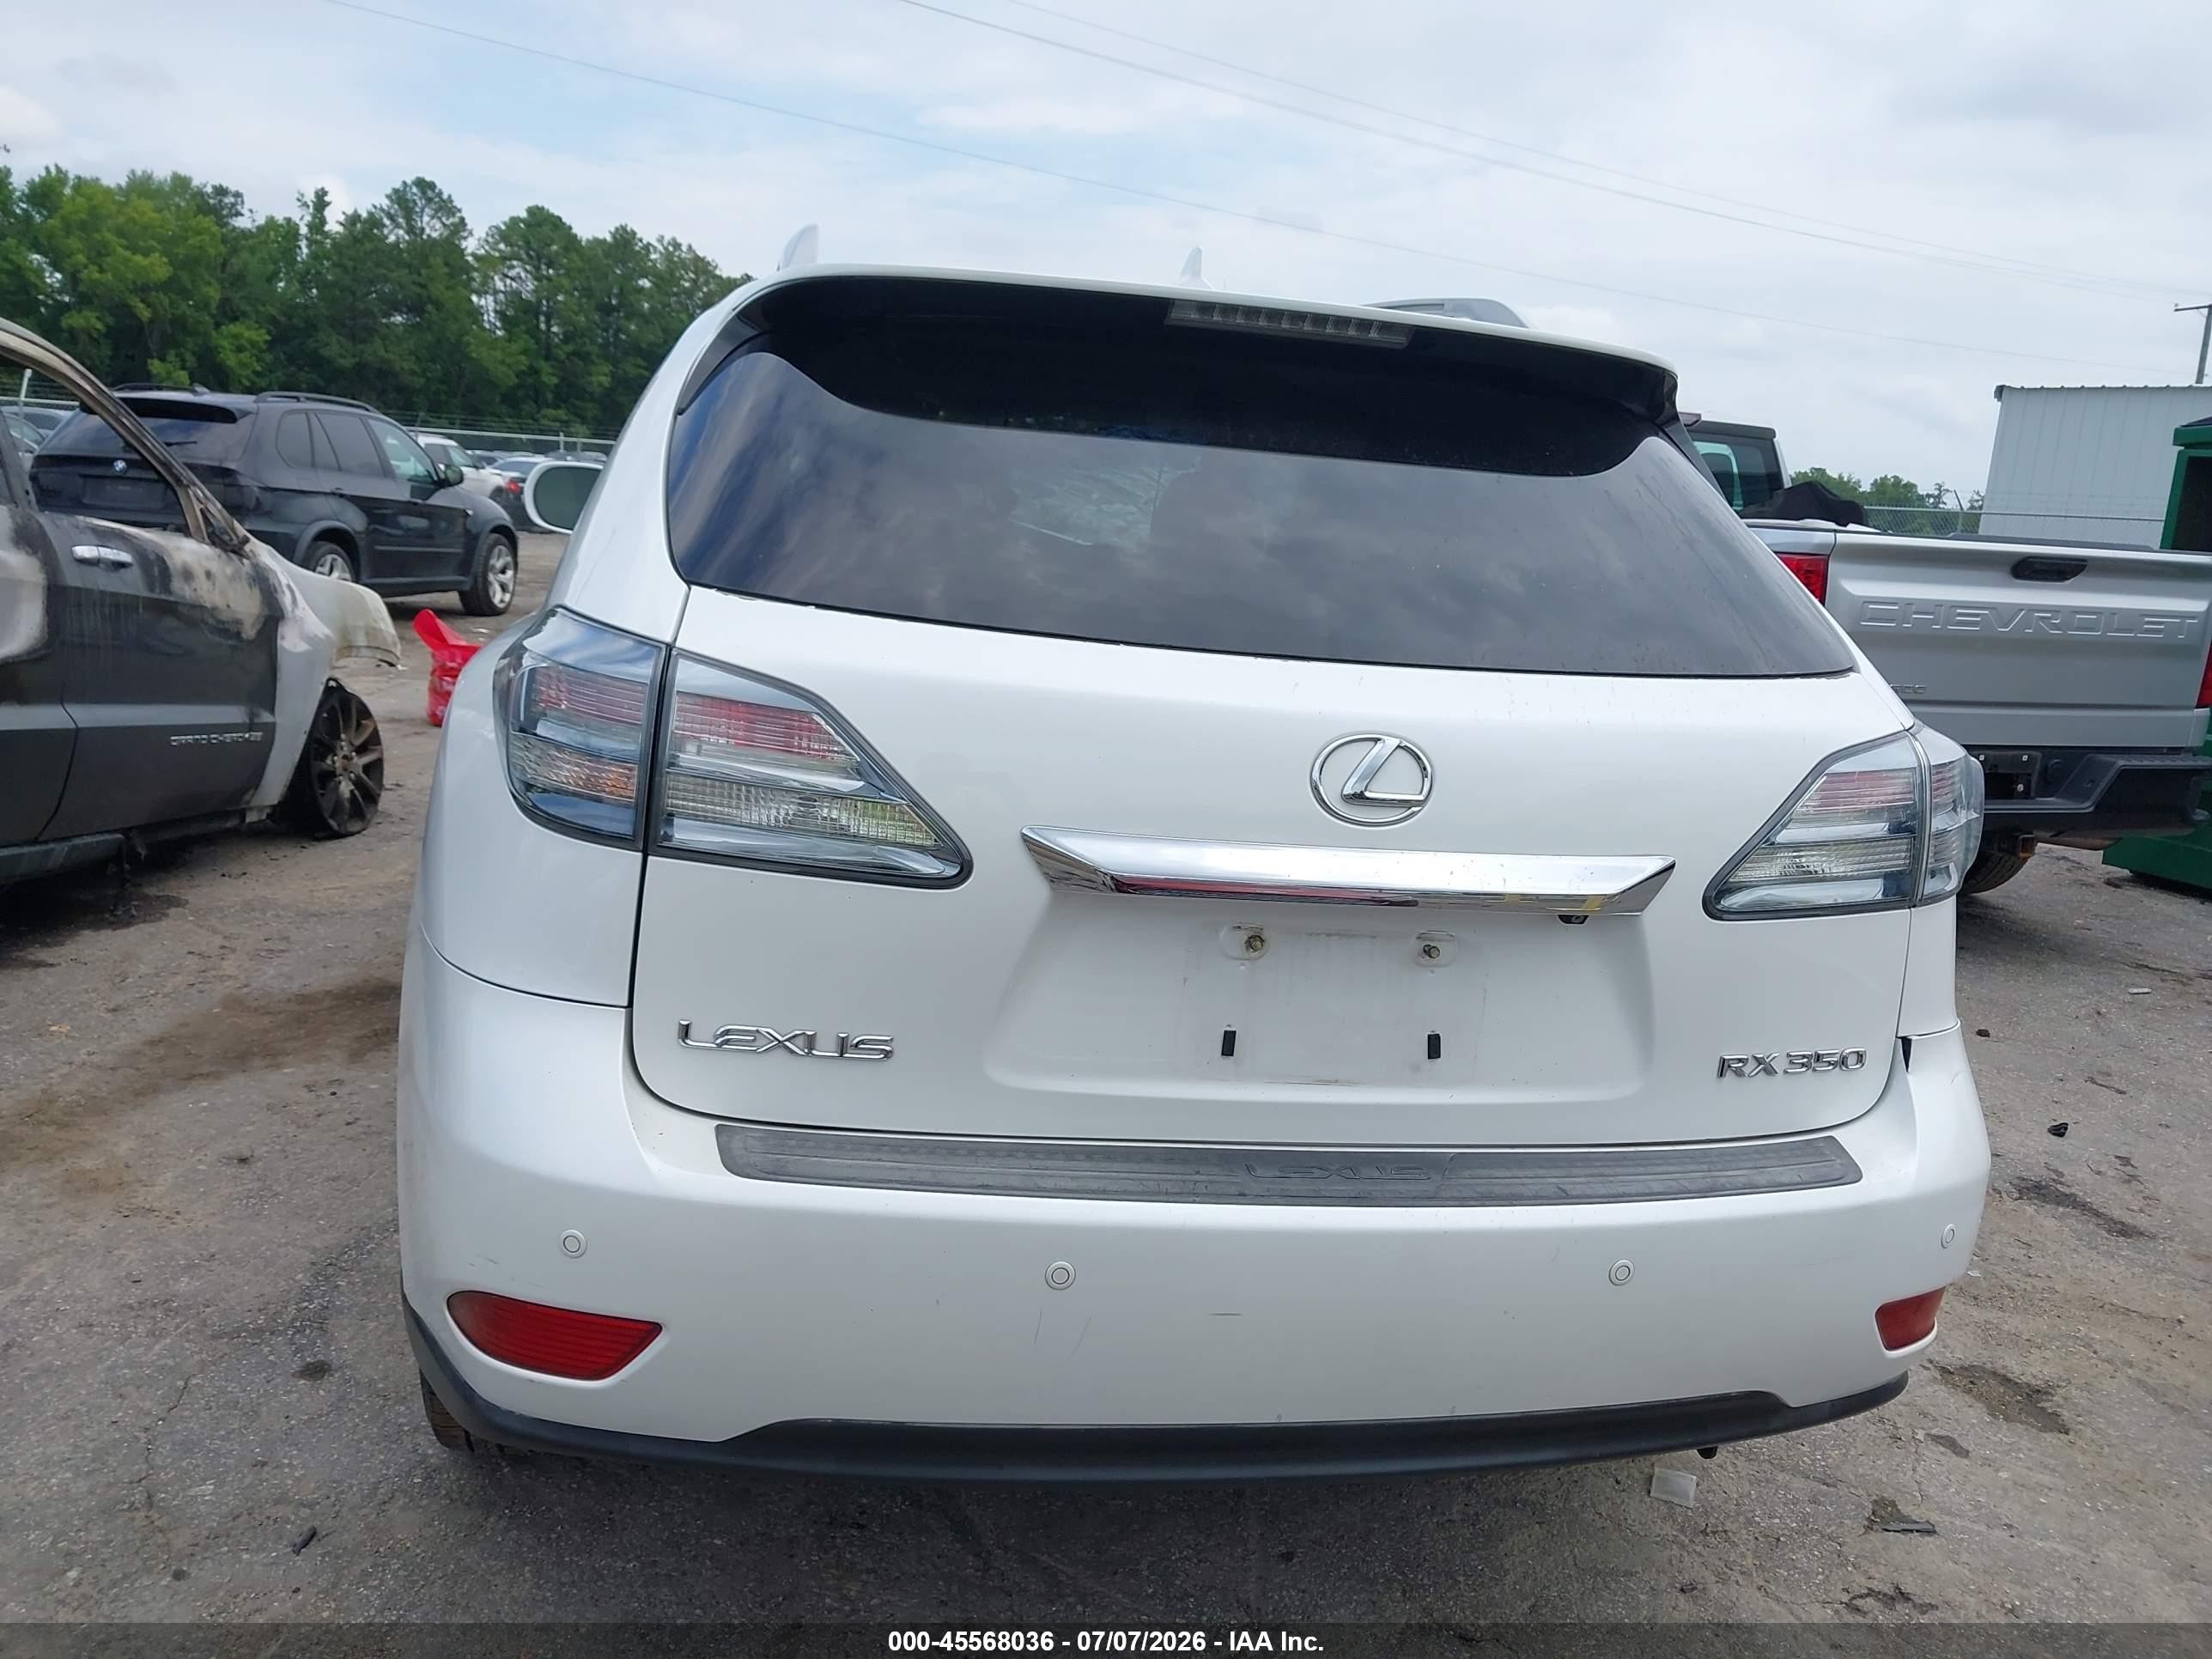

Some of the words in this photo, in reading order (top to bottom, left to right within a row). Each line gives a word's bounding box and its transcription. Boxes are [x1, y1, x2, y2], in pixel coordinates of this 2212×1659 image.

[1860, 600, 2199, 638] CHEVROLET
[677, 1019, 894, 1060] LEXUS
[1717, 1052, 1780, 1079] RX
[1783, 1047, 1868, 1074] 350
[1244, 1163, 1431, 1181] LEXUS
